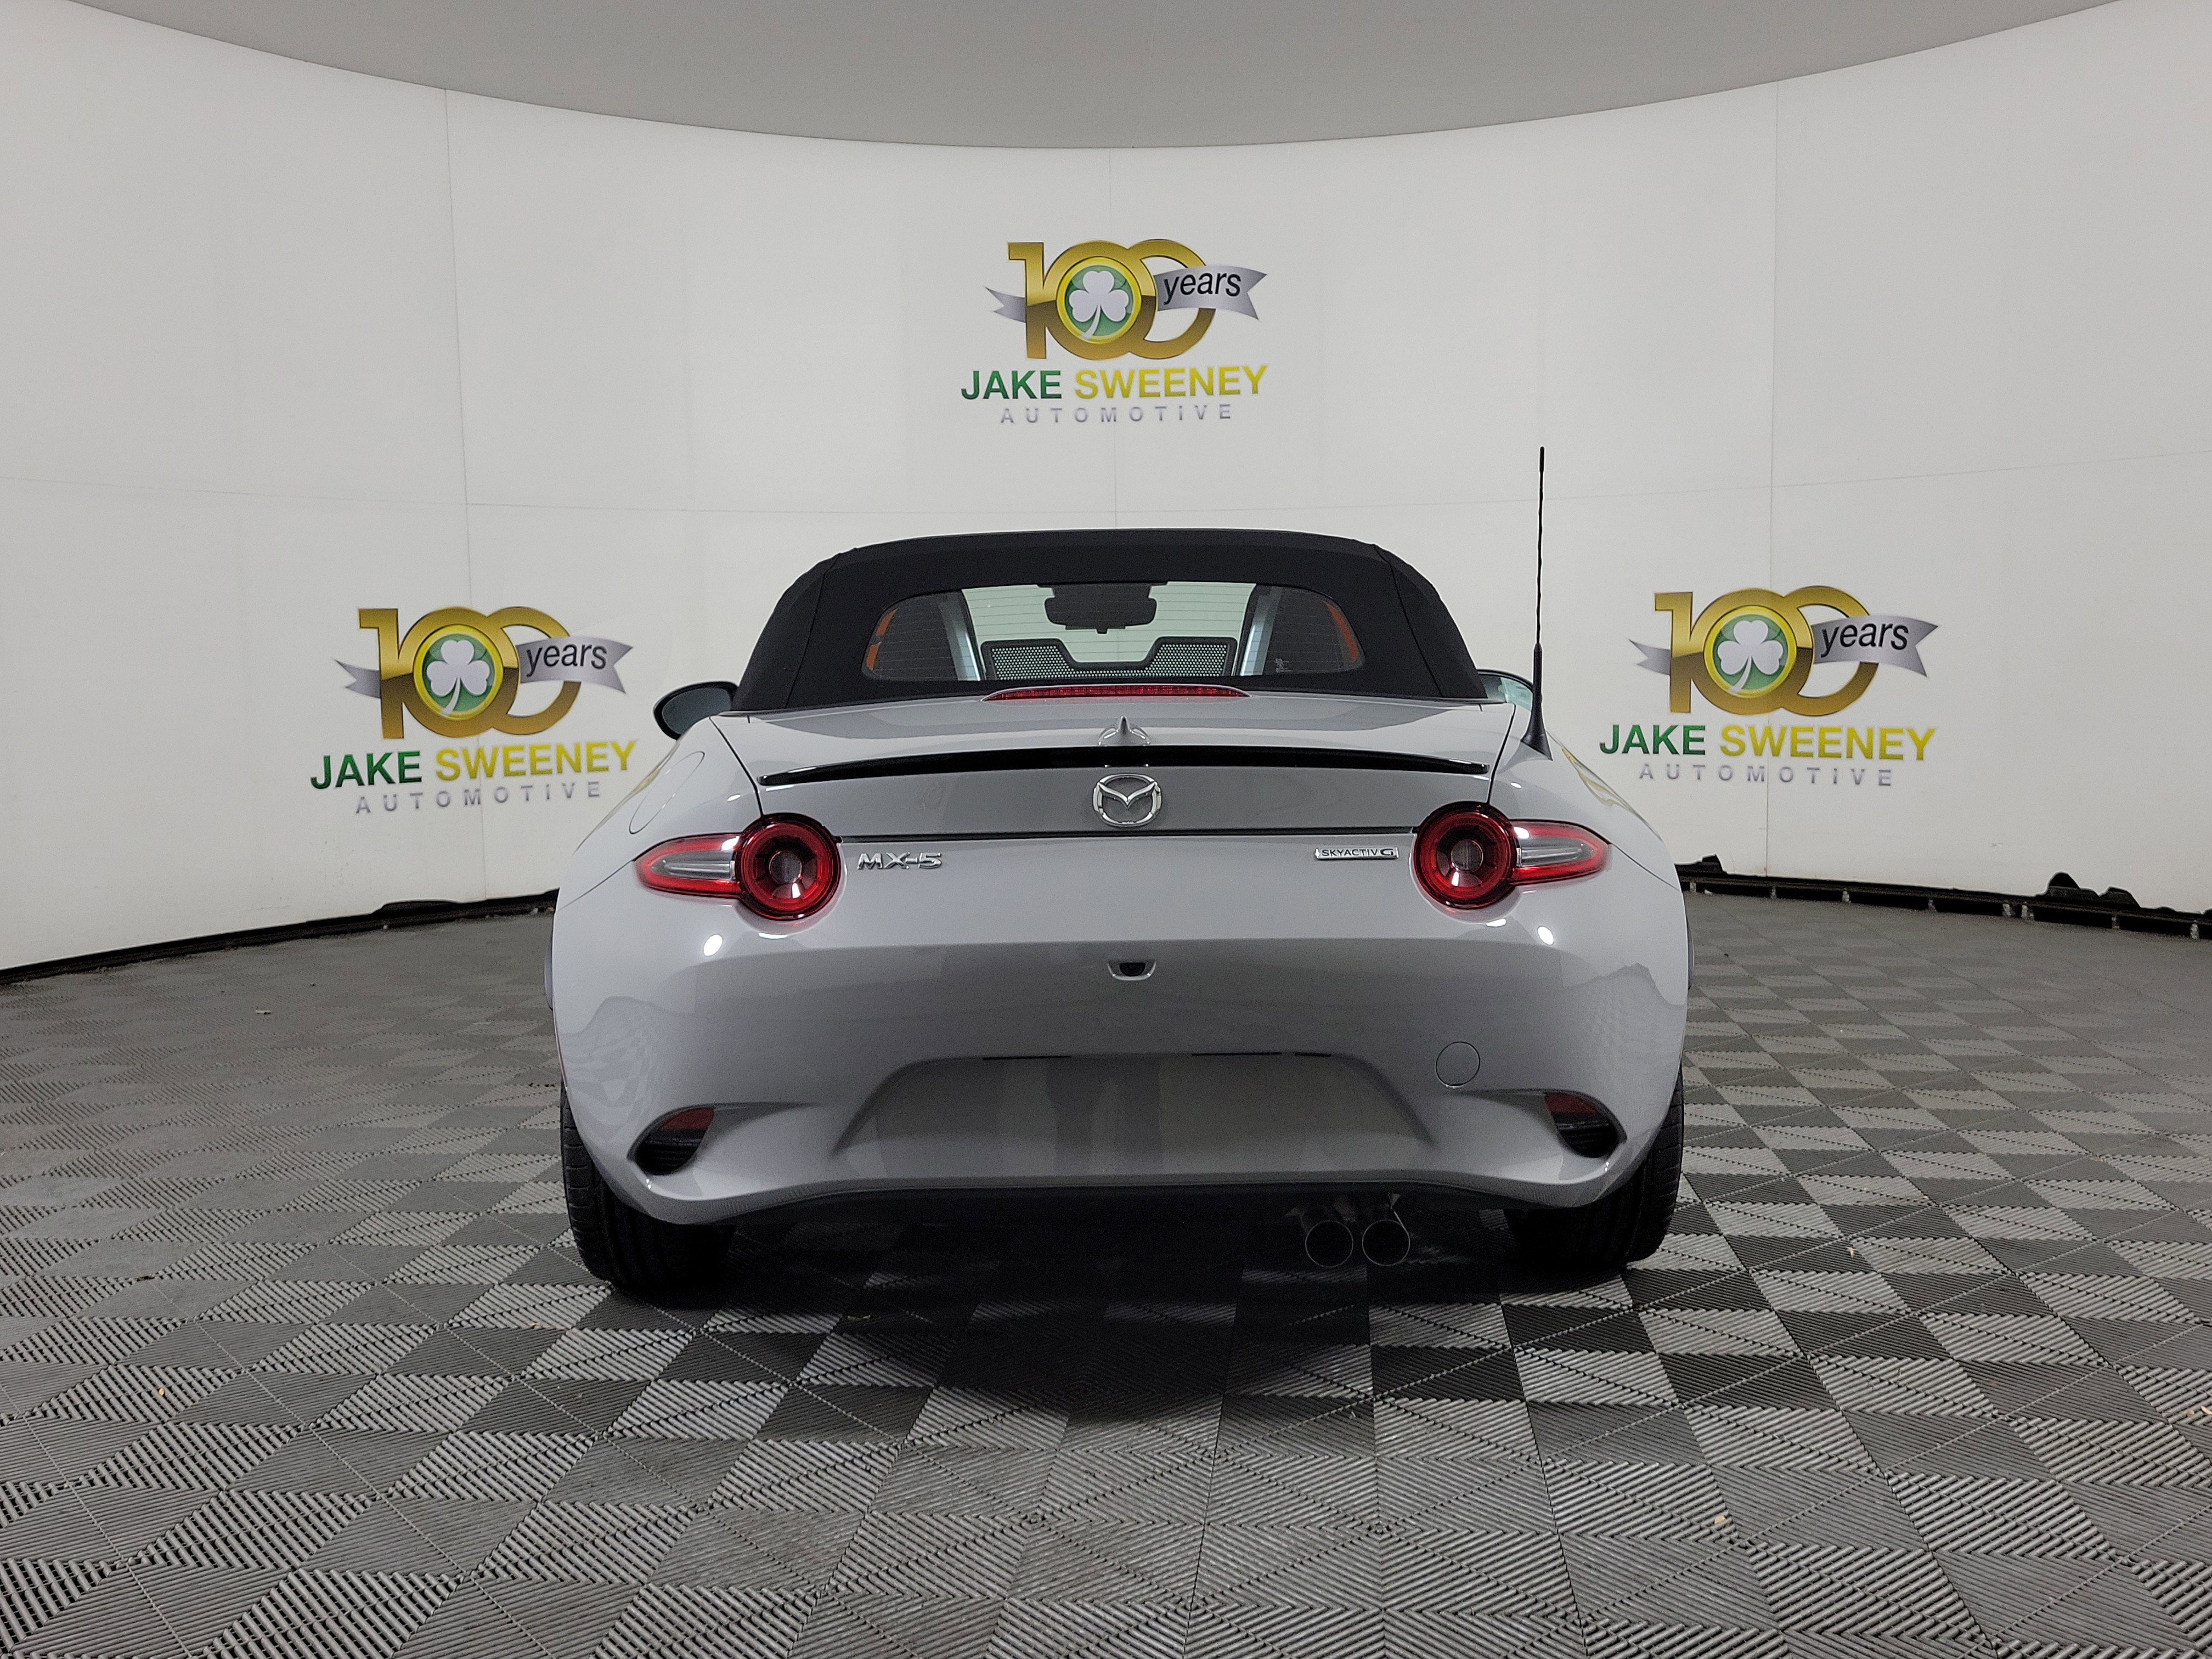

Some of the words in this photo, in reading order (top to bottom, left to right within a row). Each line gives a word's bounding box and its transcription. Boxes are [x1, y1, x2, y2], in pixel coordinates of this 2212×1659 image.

[1007, 239, 1216, 360] 100
[1163, 272, 1242, 305] years
[961, 370, 1062, 400] JAKE
[1074, 365, 1267, 399] SWEENEY
[1001, 404, 1231, 424] AUTOMOTIVE
[1654, 585, 1879, 716] 100
[1820, 621, 1910, 658] years
[358, 606, 582, 739] 100
[526, 643, 607, 678] years
[1599, 724, 1706, 755] JAKE
[1720, 724, 1936, 761] SWEENEY
[310, 750, 422, 789] JAKE
[436, 740, 636, 782] SWEENEY
[1639, 763, 1892, 786] AUTOMOTIVE
[355, 781, 600, 815] AUTOMOTIVE
[857, 852, 943, 870] MX-5
